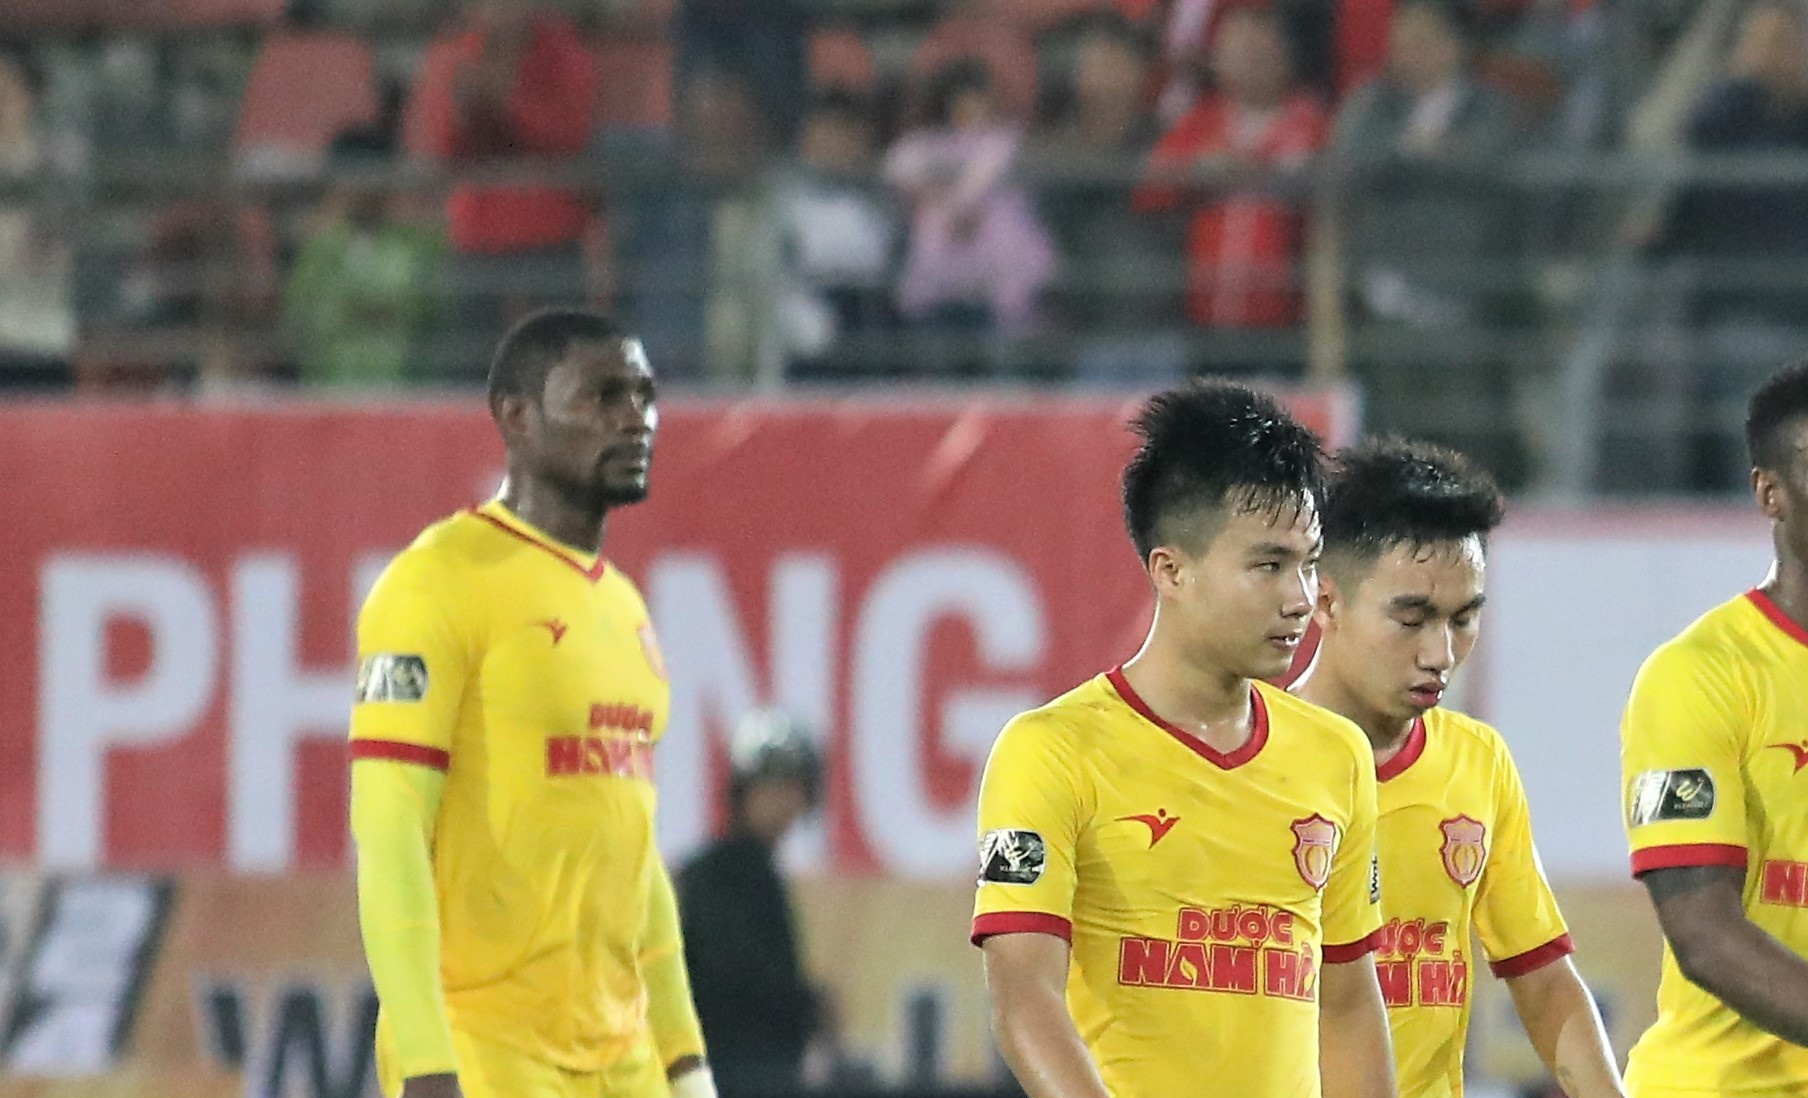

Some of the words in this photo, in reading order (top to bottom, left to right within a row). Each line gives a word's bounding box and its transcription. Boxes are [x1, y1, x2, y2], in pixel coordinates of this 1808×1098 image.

[38, 546, 1048, 875] PHNG
[1176, 904, 1295, 948] DƯỢC
[1117, 936, 1258, 995] NAM
